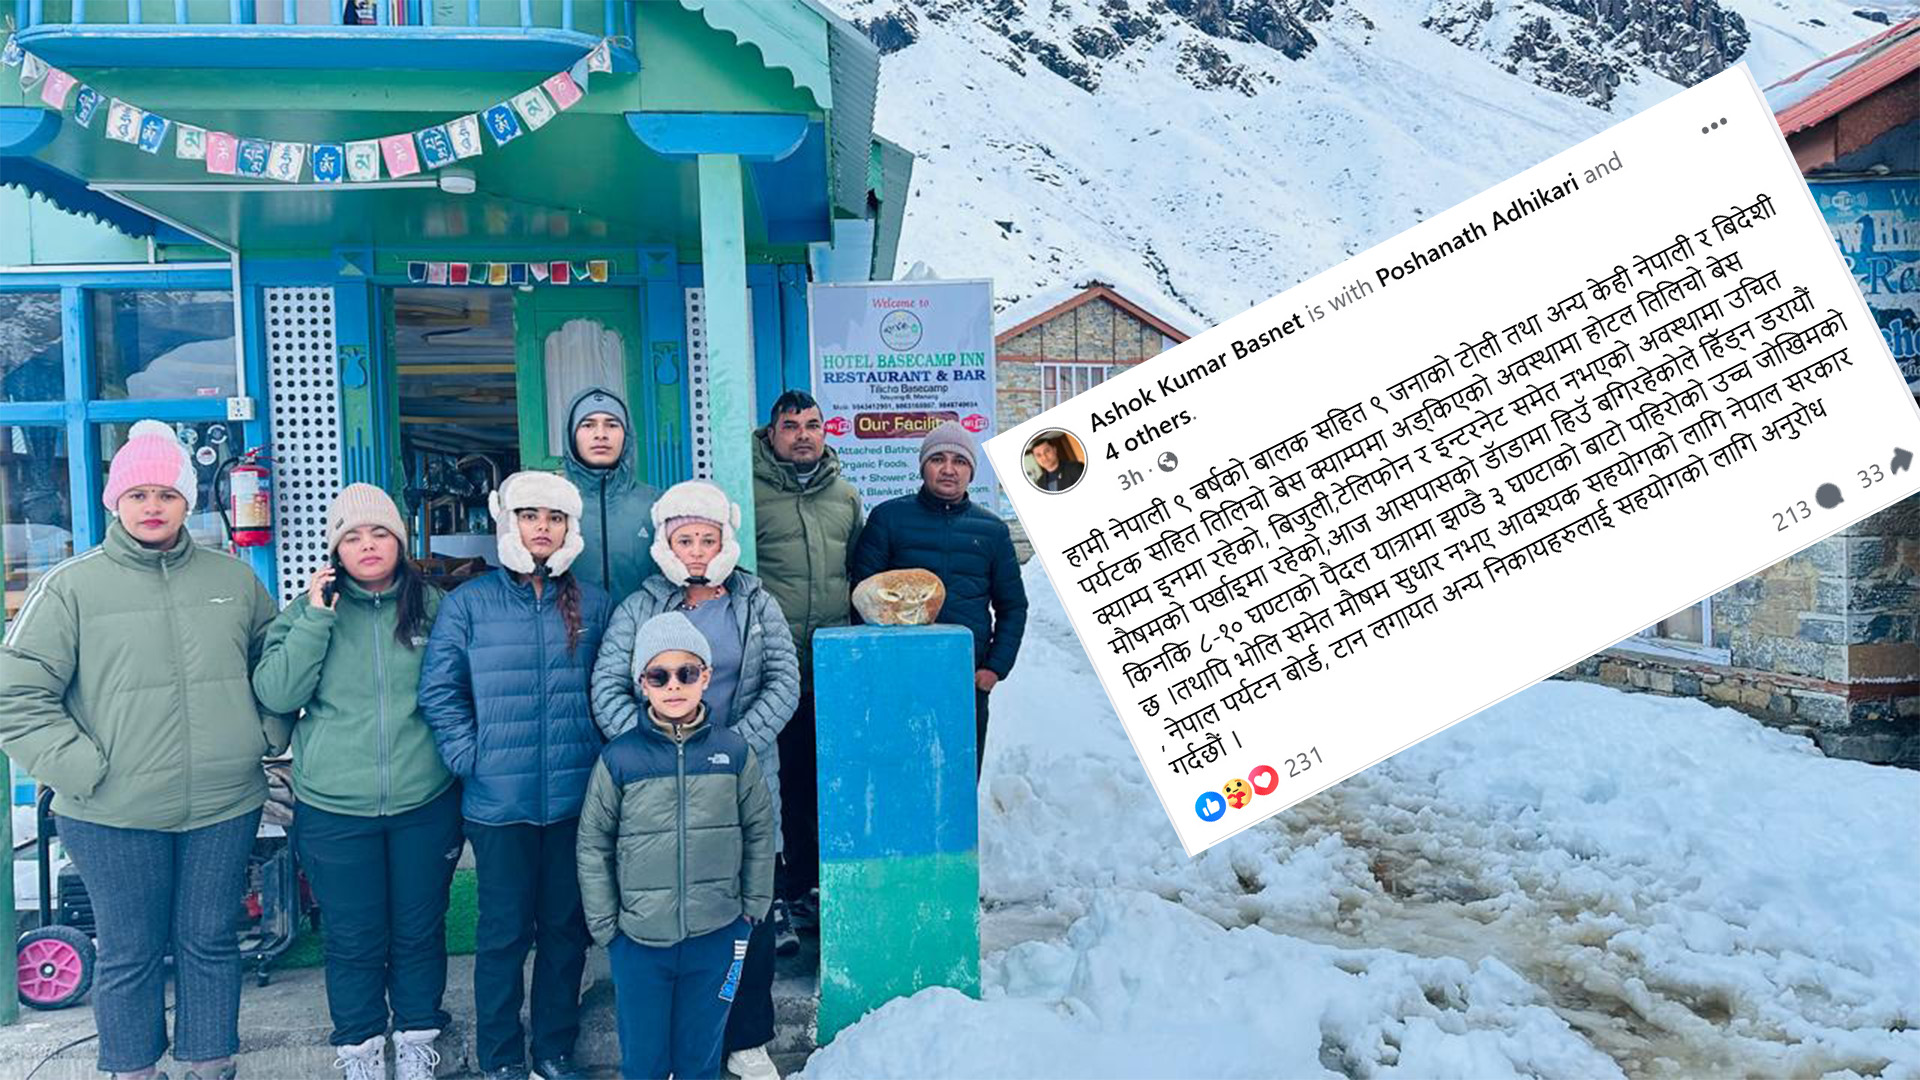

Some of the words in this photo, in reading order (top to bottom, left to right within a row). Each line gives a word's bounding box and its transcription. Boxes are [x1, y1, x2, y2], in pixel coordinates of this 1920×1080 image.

[873, 298, 915, 309] Welcome
[919, 298, 930, 309] to
[823, 354, 874, 370] HOTEL
[877, 352, 957, 369] BASECAMP
[960, 351, 985, 367] INN
[823, 371, 931, 384] RESTAURANT
[936, 370, 948, 381] &
[953, 369, 986, 382] BAR
[869, 385, 899, 394] Tilicho
[900, 384, 949, 395] Basecamp
[859, 417, 890, 432] Our
[838, 445, 883, 455] Attached
[869, 473, 907, 483] Shower
[867, 487, 904, 497] Blanket
[905, 486, 915, 496] in
